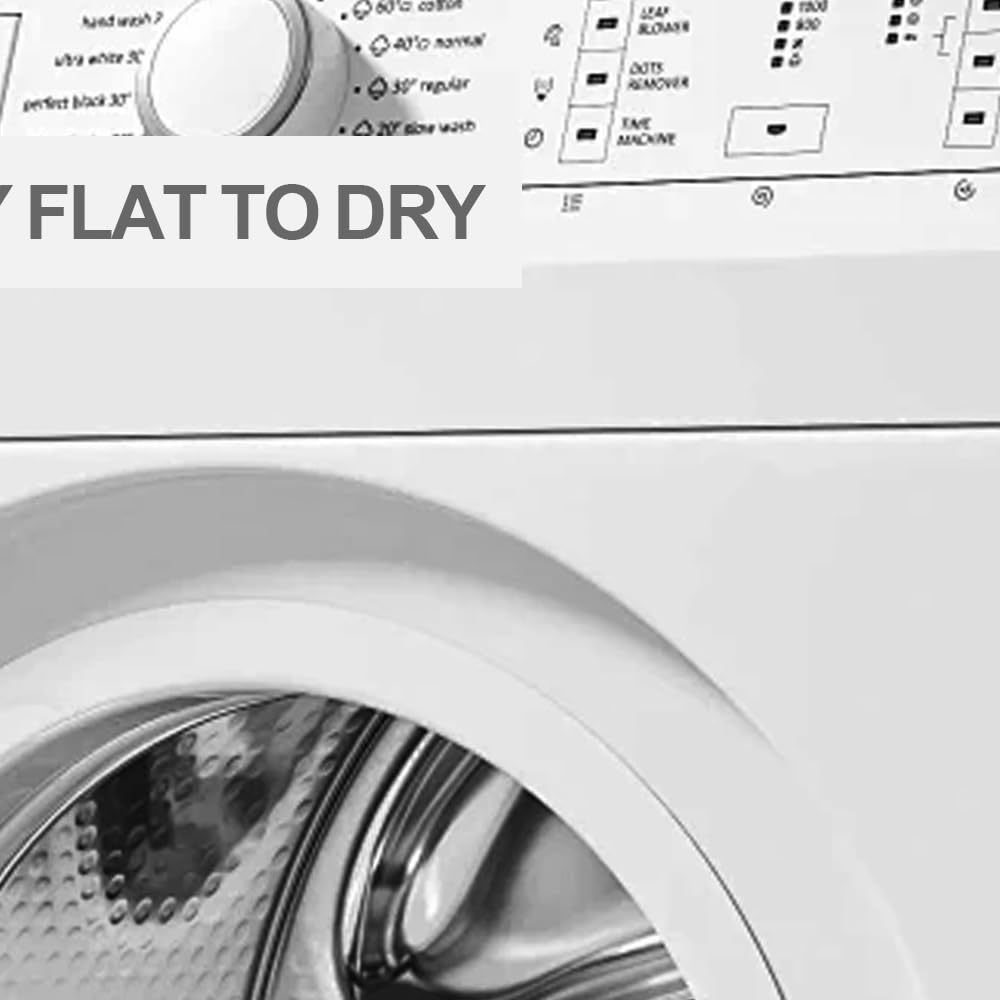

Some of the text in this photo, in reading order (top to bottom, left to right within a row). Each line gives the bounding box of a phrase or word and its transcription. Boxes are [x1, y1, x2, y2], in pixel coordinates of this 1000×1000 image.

[629, 61, 664, 76] DOTS
[626, 76, 690, 91] REMOVER
[615, 133, 677, 147] MACHINE
